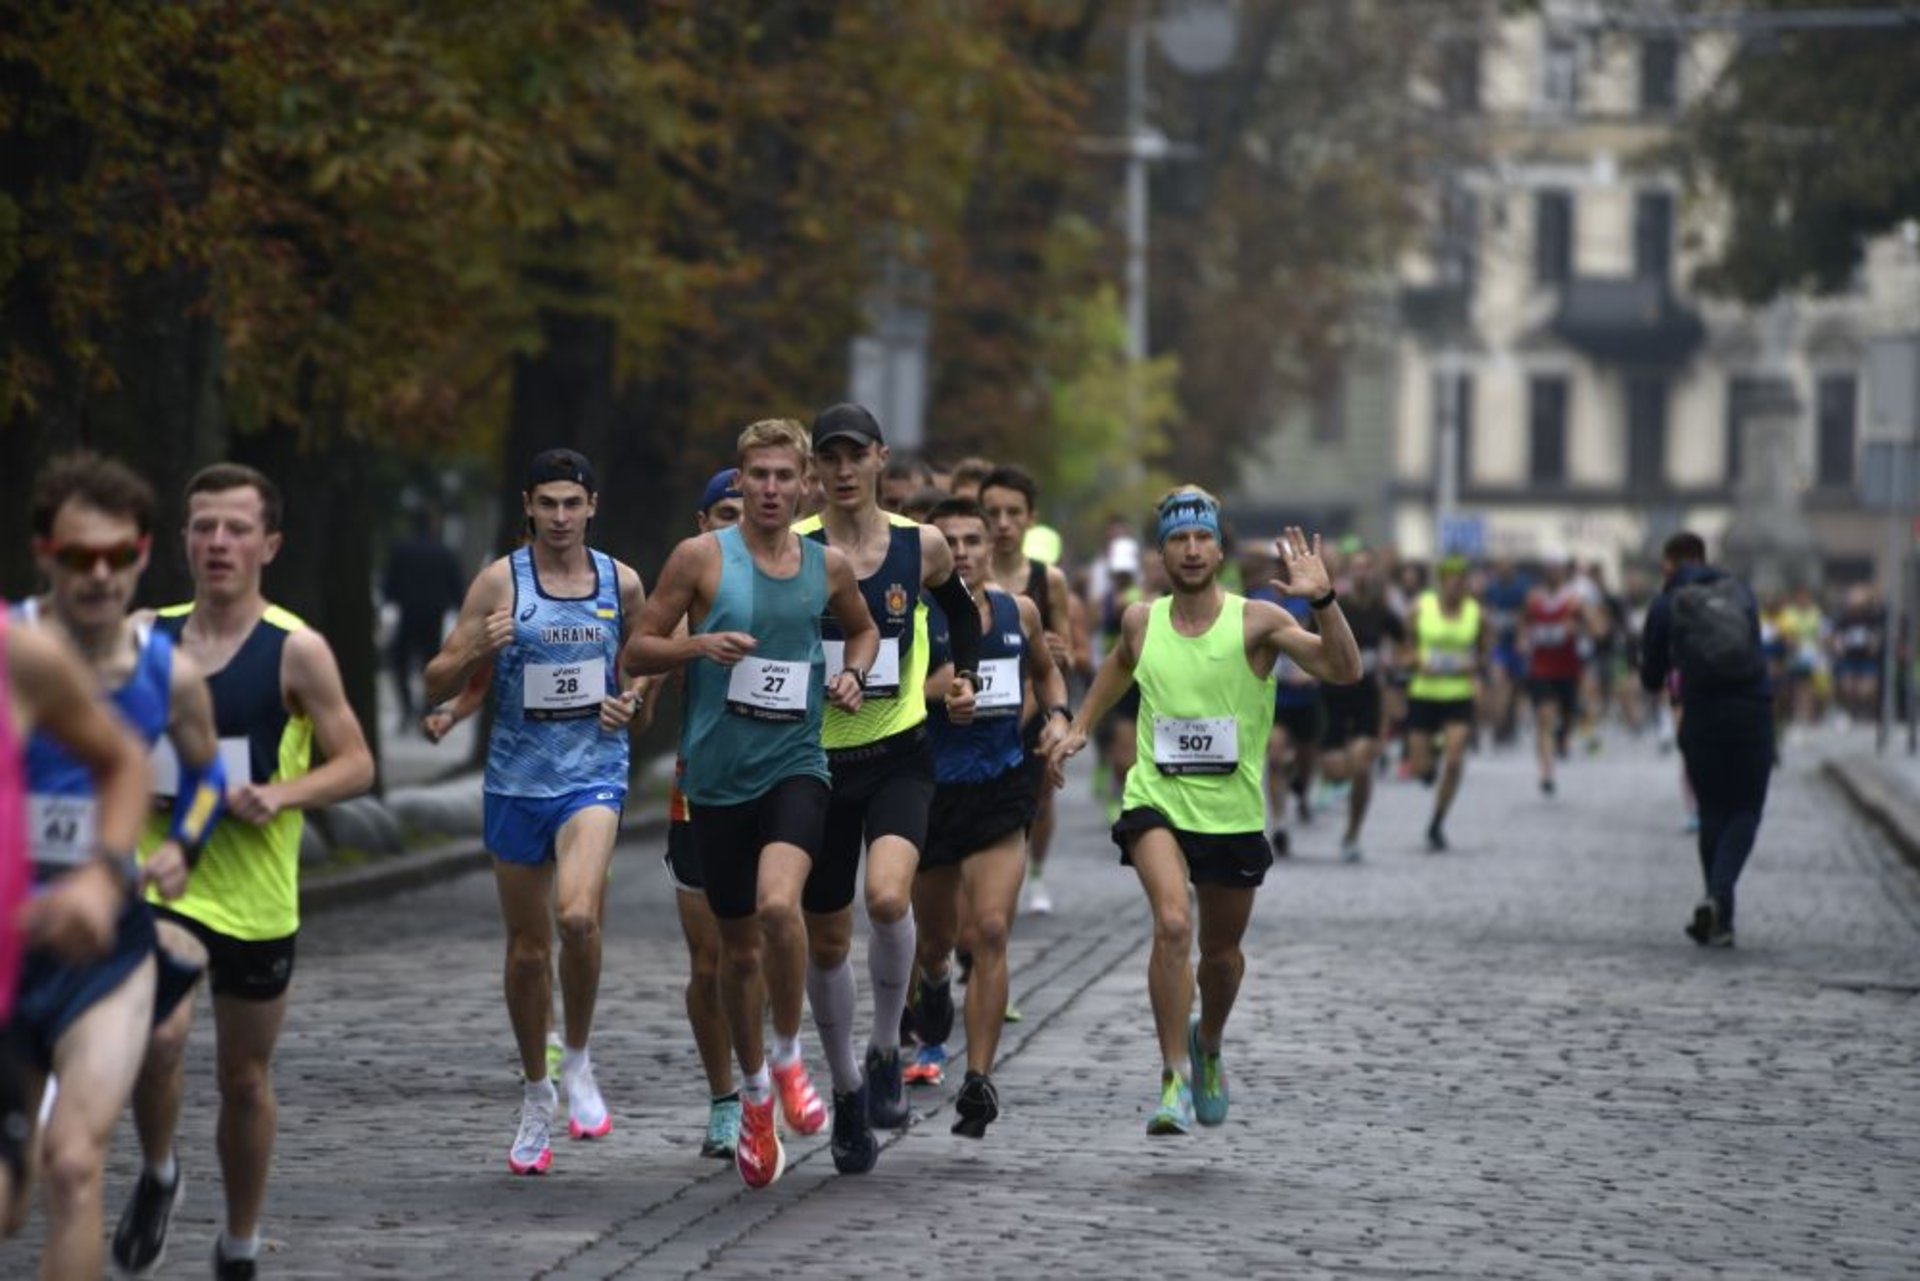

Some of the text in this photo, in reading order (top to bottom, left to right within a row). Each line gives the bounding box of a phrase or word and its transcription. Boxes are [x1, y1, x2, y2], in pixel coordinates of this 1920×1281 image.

[543, 627, 602, 644] UKRAINE
[556, 678, 578, 694] 28
[763, 676, 786, 693] 27
[1179, 734, 1213, 751] 507
